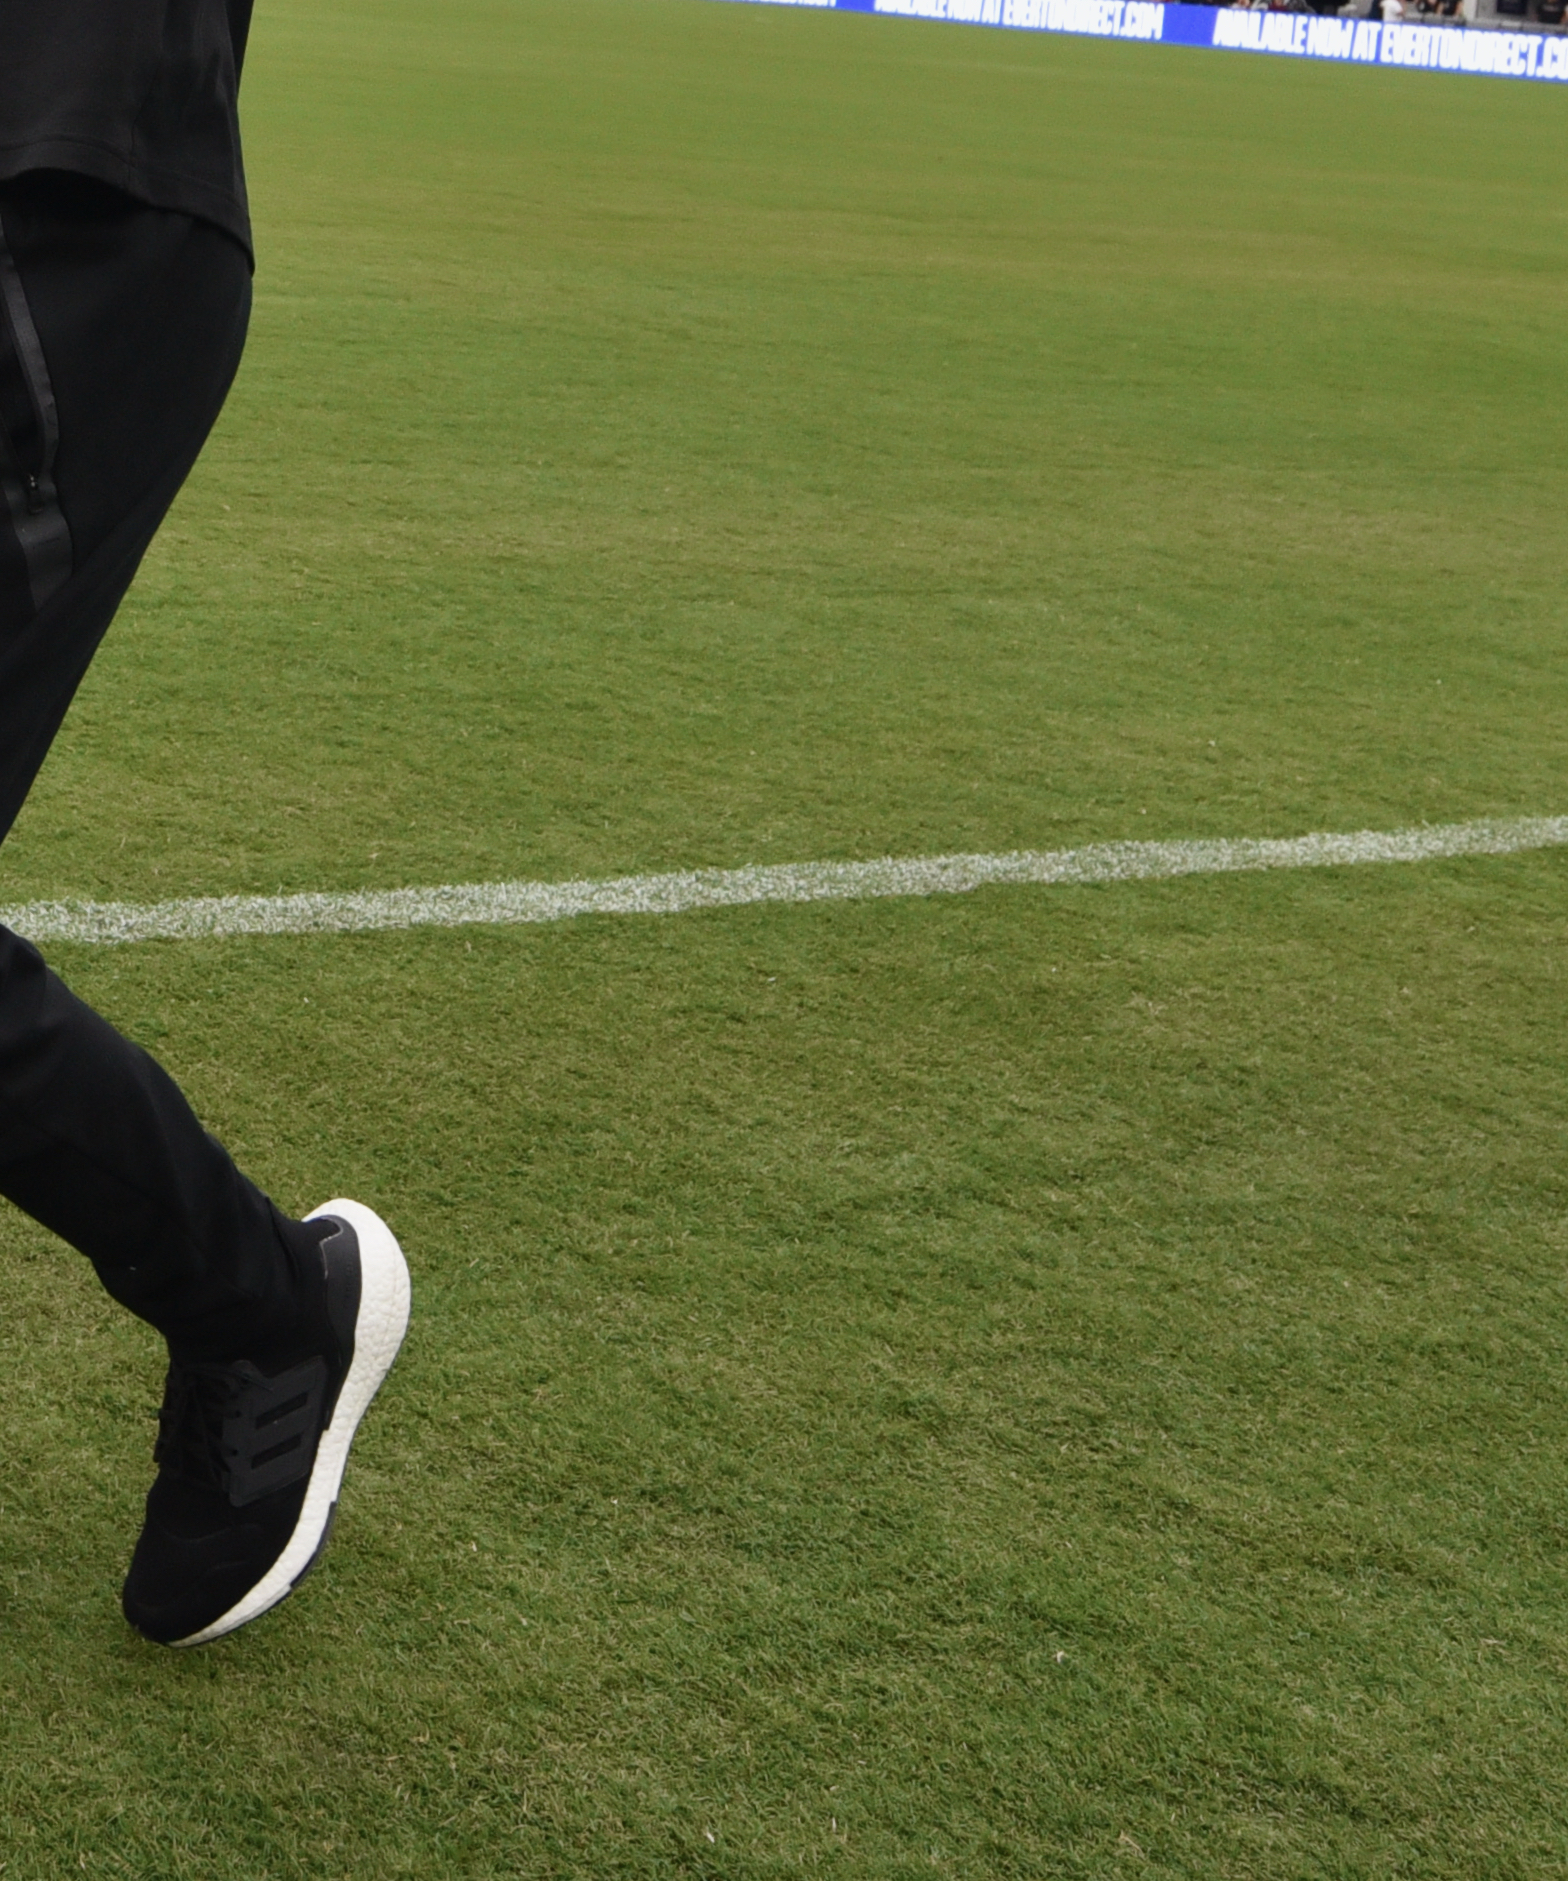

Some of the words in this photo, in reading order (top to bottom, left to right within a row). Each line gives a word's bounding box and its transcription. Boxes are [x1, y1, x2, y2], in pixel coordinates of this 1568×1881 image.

[1212, 7, 1310, 55] AVAILABLE
[1306, 15, 1355, 60] NOW
[1352, 19, 1383, 63] AT
[1380, 22, 1568, 81] EVERTONDIRECT.CO
